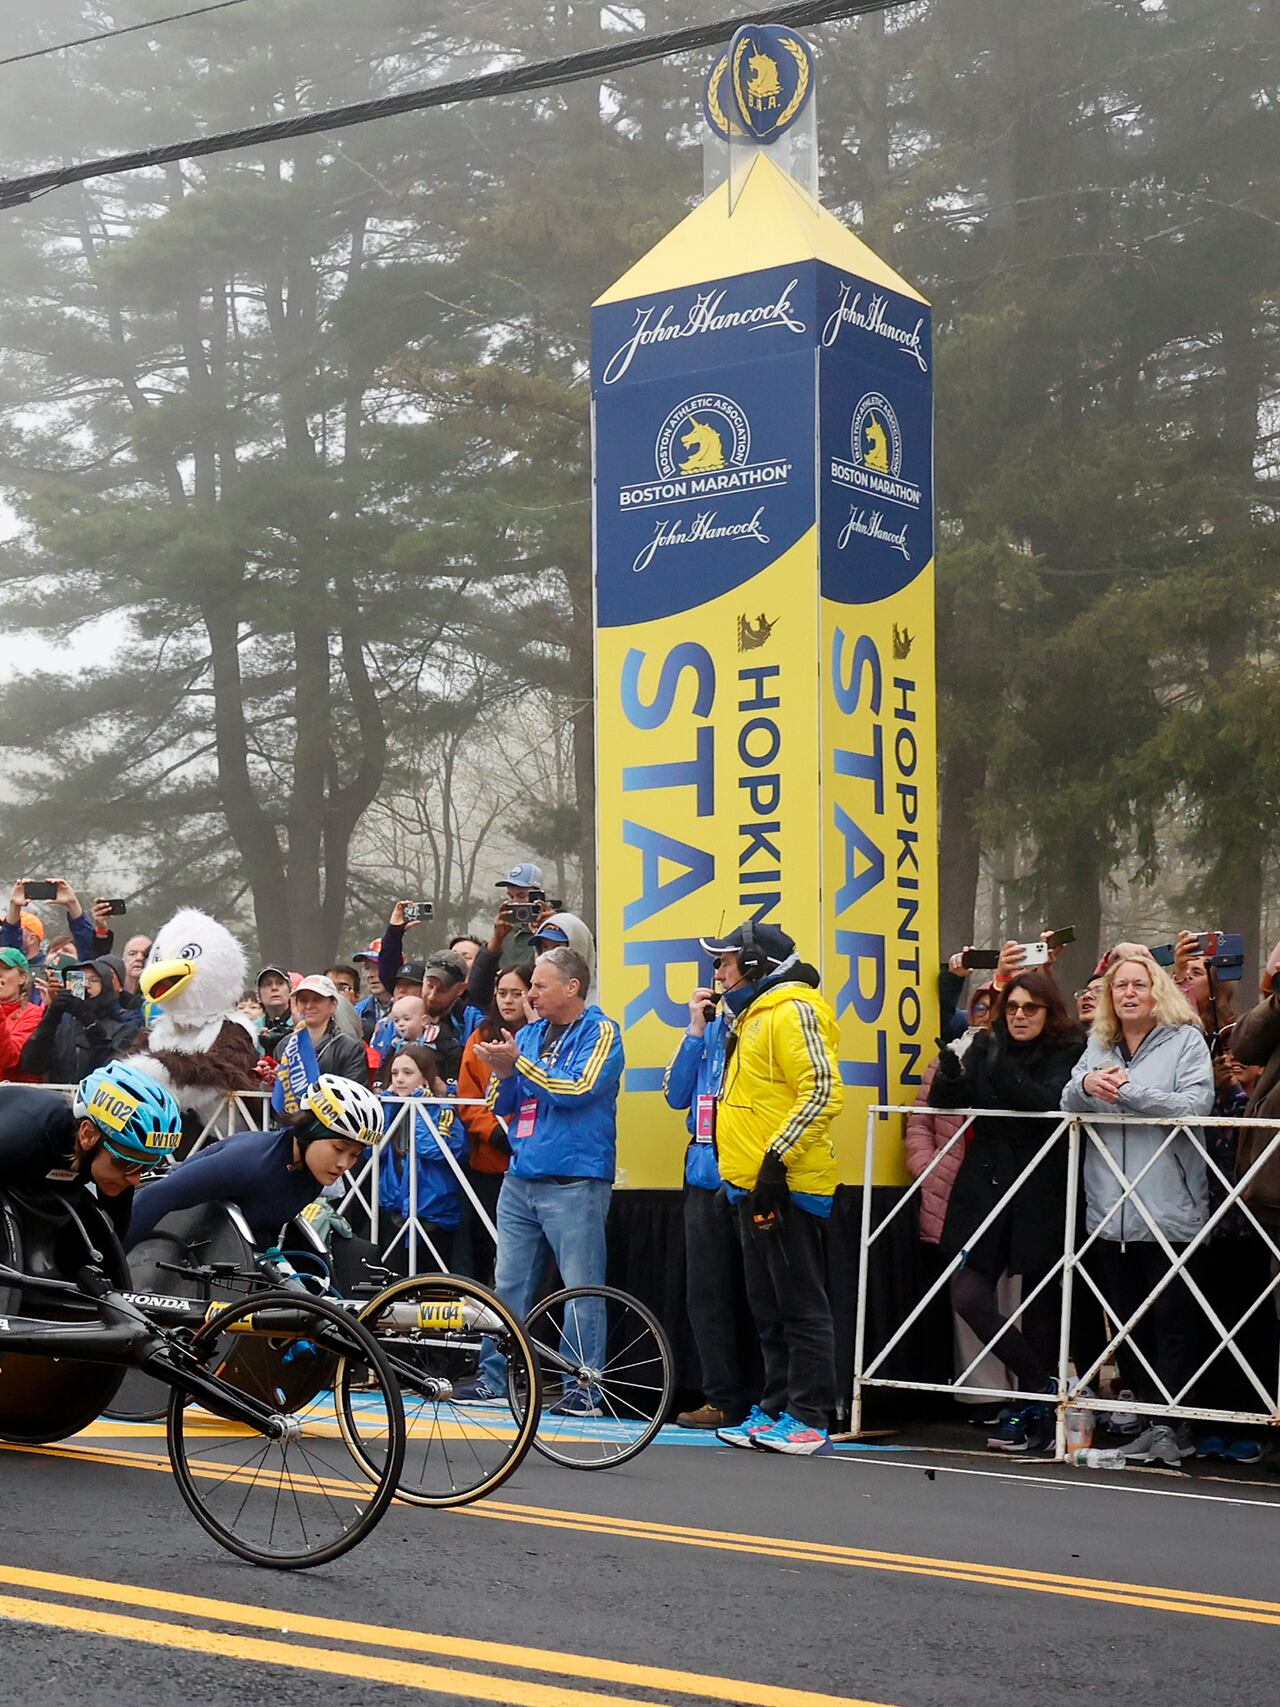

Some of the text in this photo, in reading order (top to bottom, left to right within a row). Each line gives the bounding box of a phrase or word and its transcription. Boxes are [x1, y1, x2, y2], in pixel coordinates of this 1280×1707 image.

[603, 279, 806, 384] John Hancock
[822, 281, 928, 372] John Hancock
[660, 398, 746, 474] BOSTON ATHLETIC ASSOCIATION
[620, 465, 787, 506] BOSTON MARATHON
[831, 462, 921, 503] BOSTON MARATHON
[633, 506, 770, 572] John Hancock
[837, 504, 910, 561] John Hancock
[621, 641, 716, 1093] STAR
[833, 626, 888, 1120] START
[893, 677, 921, 1086] HOPKINTON
[92, 1088, 134, 1122] W102
[312, 1093, 339, 1121] W104
[122, 1292, 191, 1311] HONDA
[422, 1305, 459, 1320] W104
